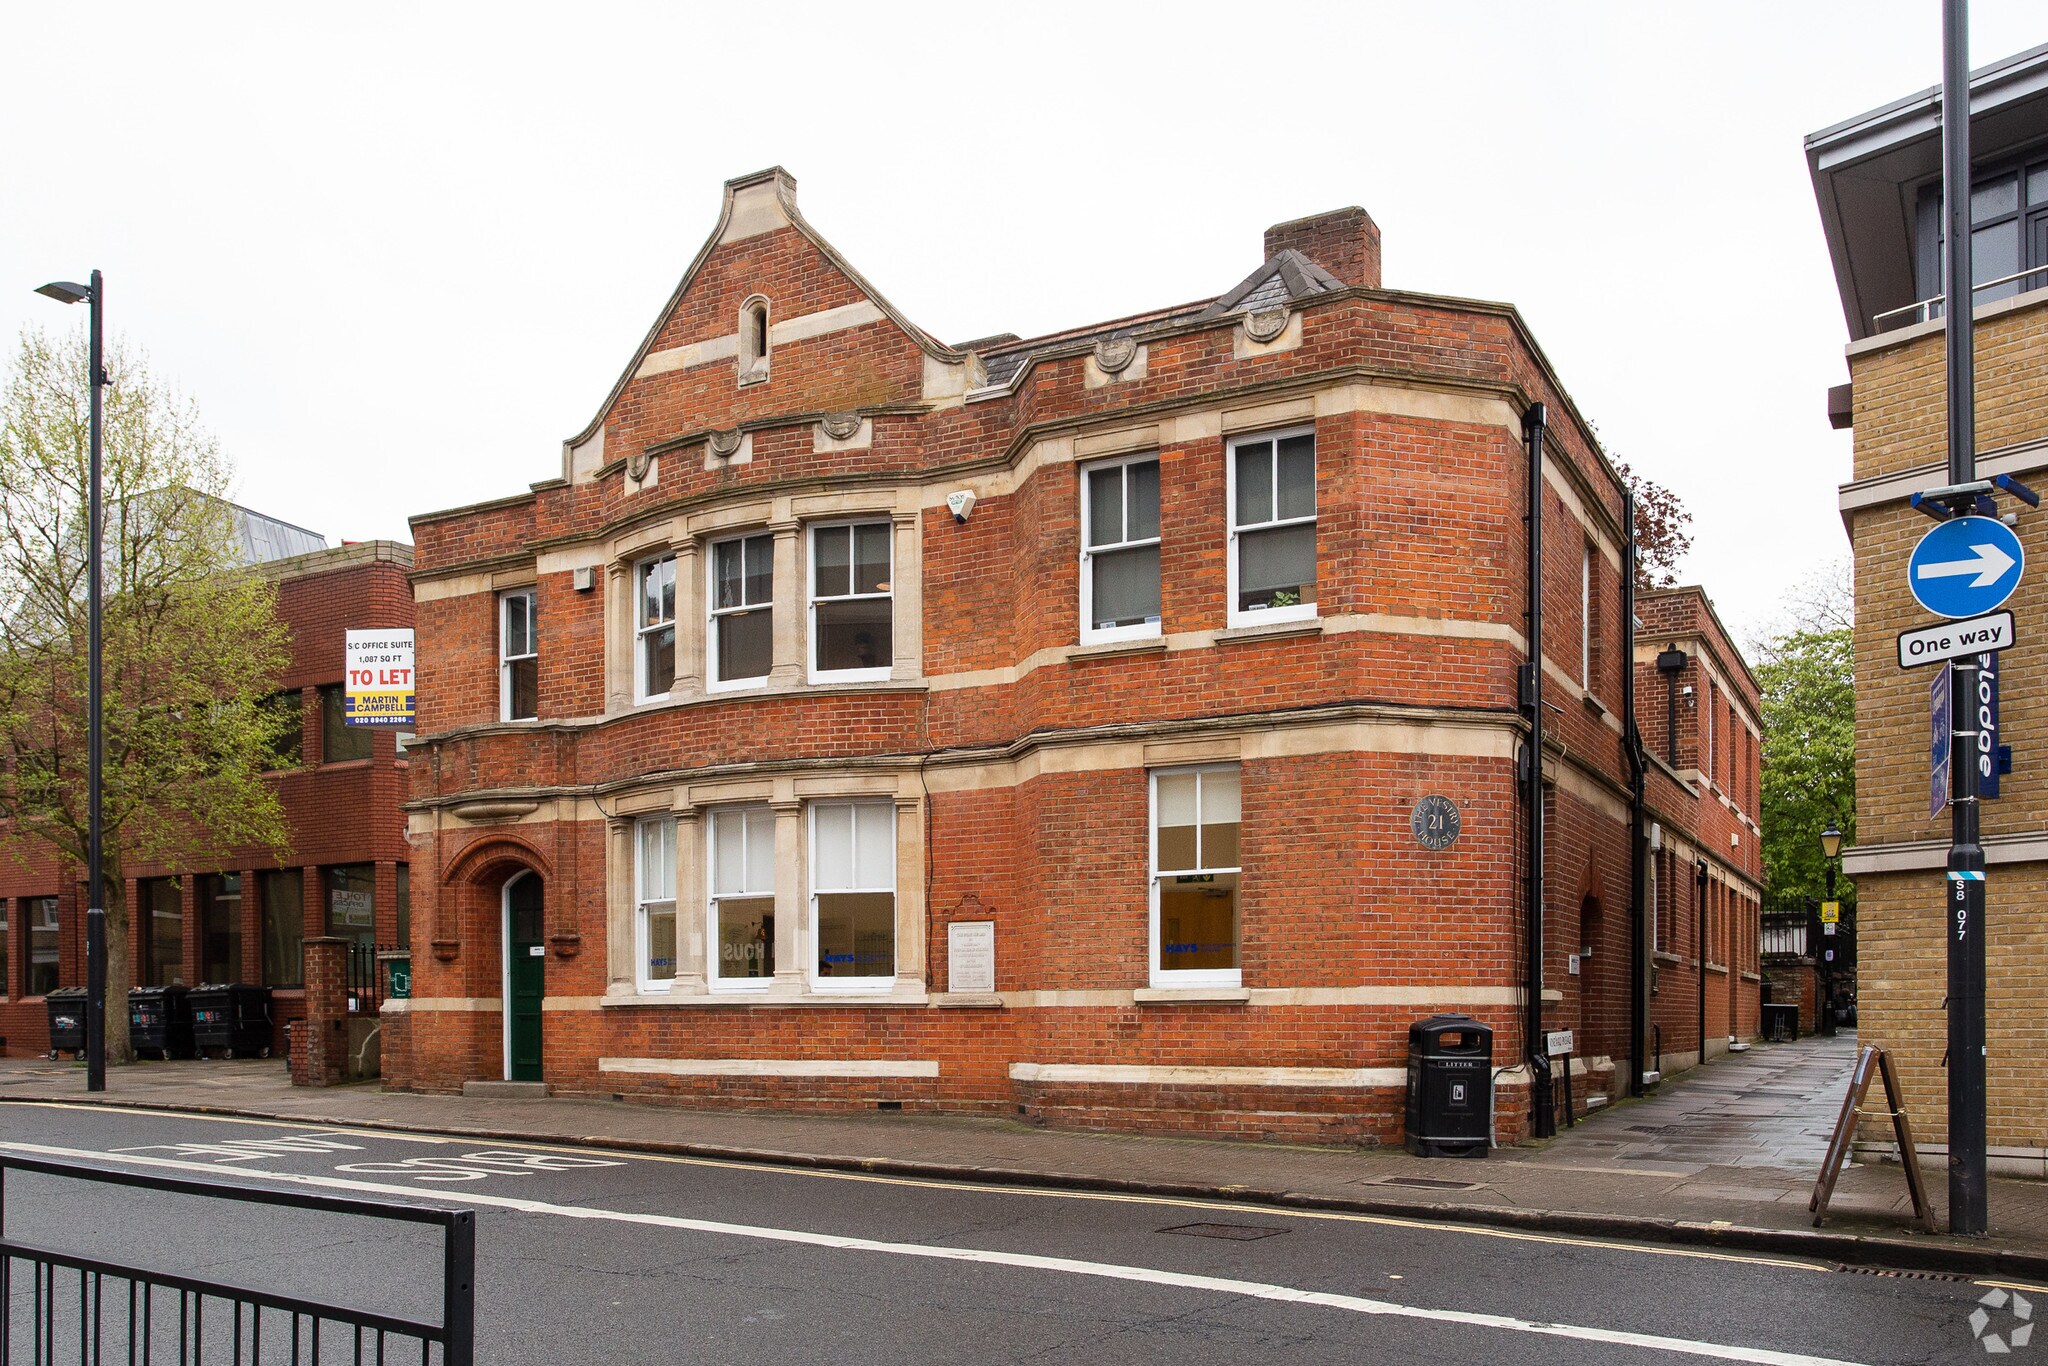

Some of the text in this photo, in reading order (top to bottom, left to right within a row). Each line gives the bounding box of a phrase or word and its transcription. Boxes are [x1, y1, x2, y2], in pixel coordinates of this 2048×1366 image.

[1908, 624, 2003, 656] One way
[362, 641, 388, 650] OFFICE
[390, 641, 413, 649] SUITE
[359, 655, 378, 664] 1,087
[380, 655, 391, 663] SQ
[349, 669, 411, 686] TO LET
[362, 695, 399, 704] MARTIN
[356, 703, 405, 712] CAMPBELL
[1414, 798, 1459, 846] THE VESTRY HOUSE
[1428, 814, 1444, 830] 21
[1165, 943, 1198, 954] HAYS
[650, 958, 668, 967] HAYS
[824, 953, 855, 963] HAYS
